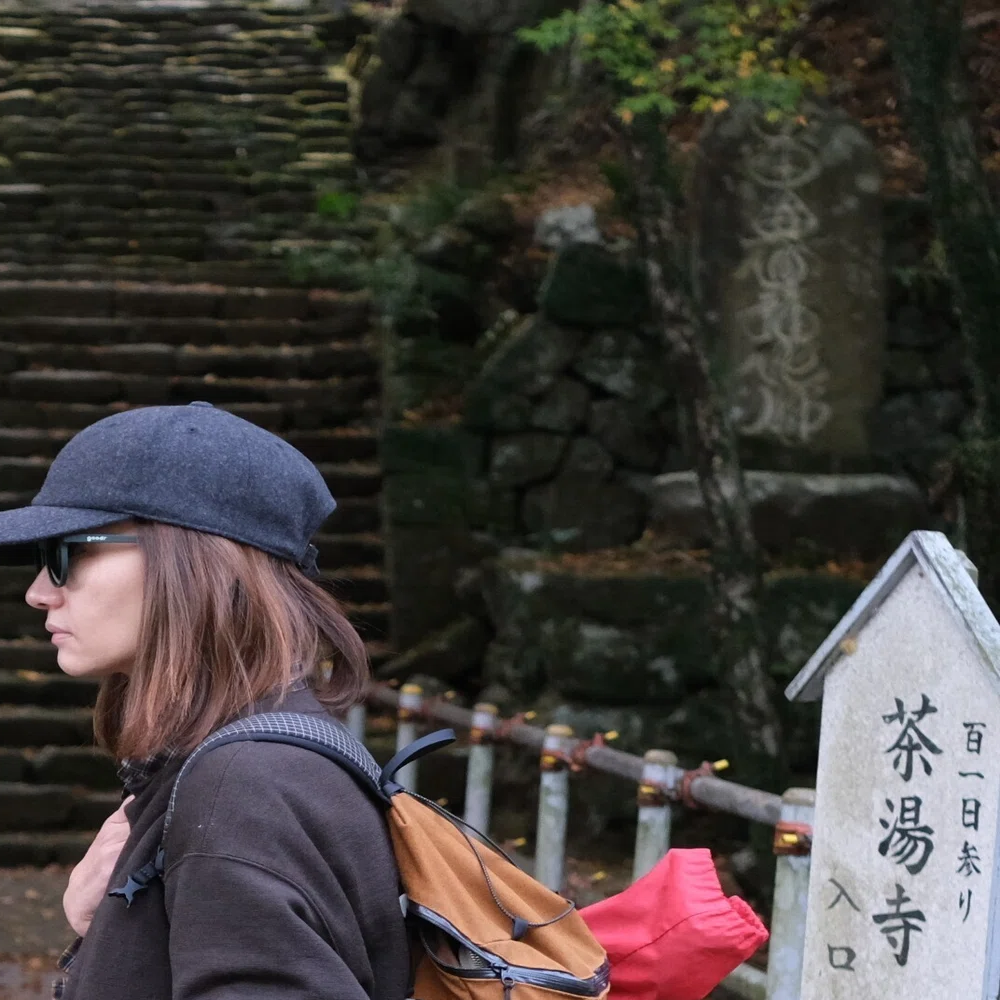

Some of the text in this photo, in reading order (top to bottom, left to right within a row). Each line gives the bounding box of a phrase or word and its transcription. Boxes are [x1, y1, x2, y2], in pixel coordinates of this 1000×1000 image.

[873, 694, 943, 967] 茶湯寺
[956, 721, 987, 923] 百一日参り
[828, 878, 861, 972] 入口
